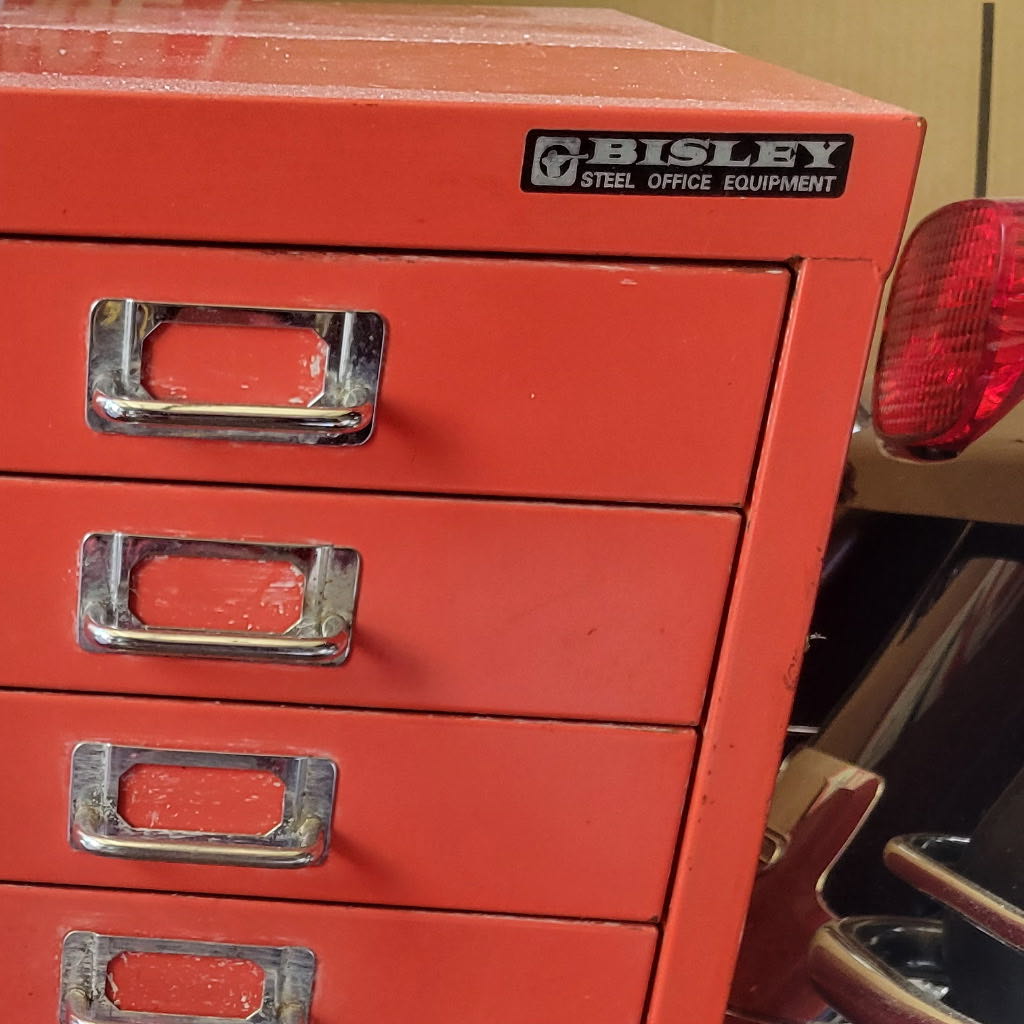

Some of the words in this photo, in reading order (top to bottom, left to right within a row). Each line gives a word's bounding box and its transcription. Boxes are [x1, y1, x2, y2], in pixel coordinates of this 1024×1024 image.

[585, 136, 846, 169] BISLEY
[580, 171, 635, 189] STEEL
[647, 173, 713, 191] OFFICE
[723, 174, 837, 193] EQUIPMENT
